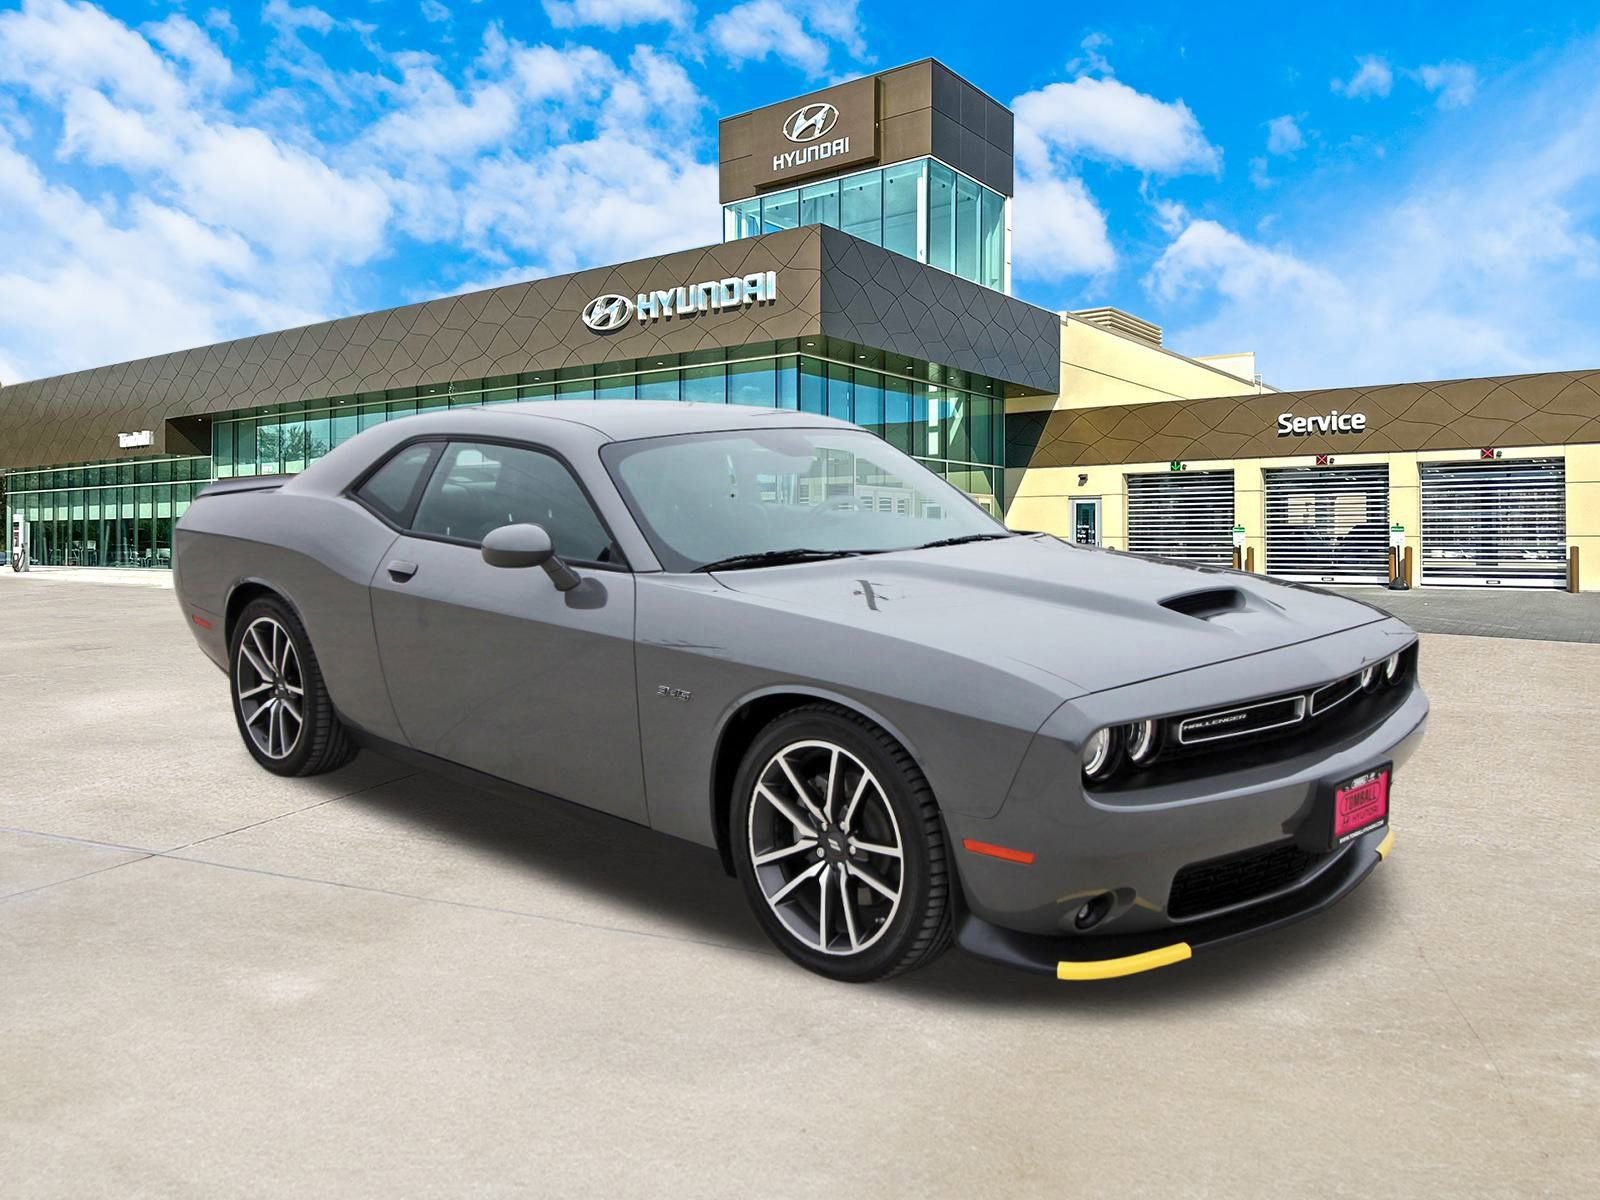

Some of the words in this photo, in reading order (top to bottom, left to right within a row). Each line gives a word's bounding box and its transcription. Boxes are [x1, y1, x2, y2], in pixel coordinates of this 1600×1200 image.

[773, 136, 849, 171] HYUNDAI
[637, 271, 777, 321] HYUNDAI
[1277, 410, 1366, 434] Service
